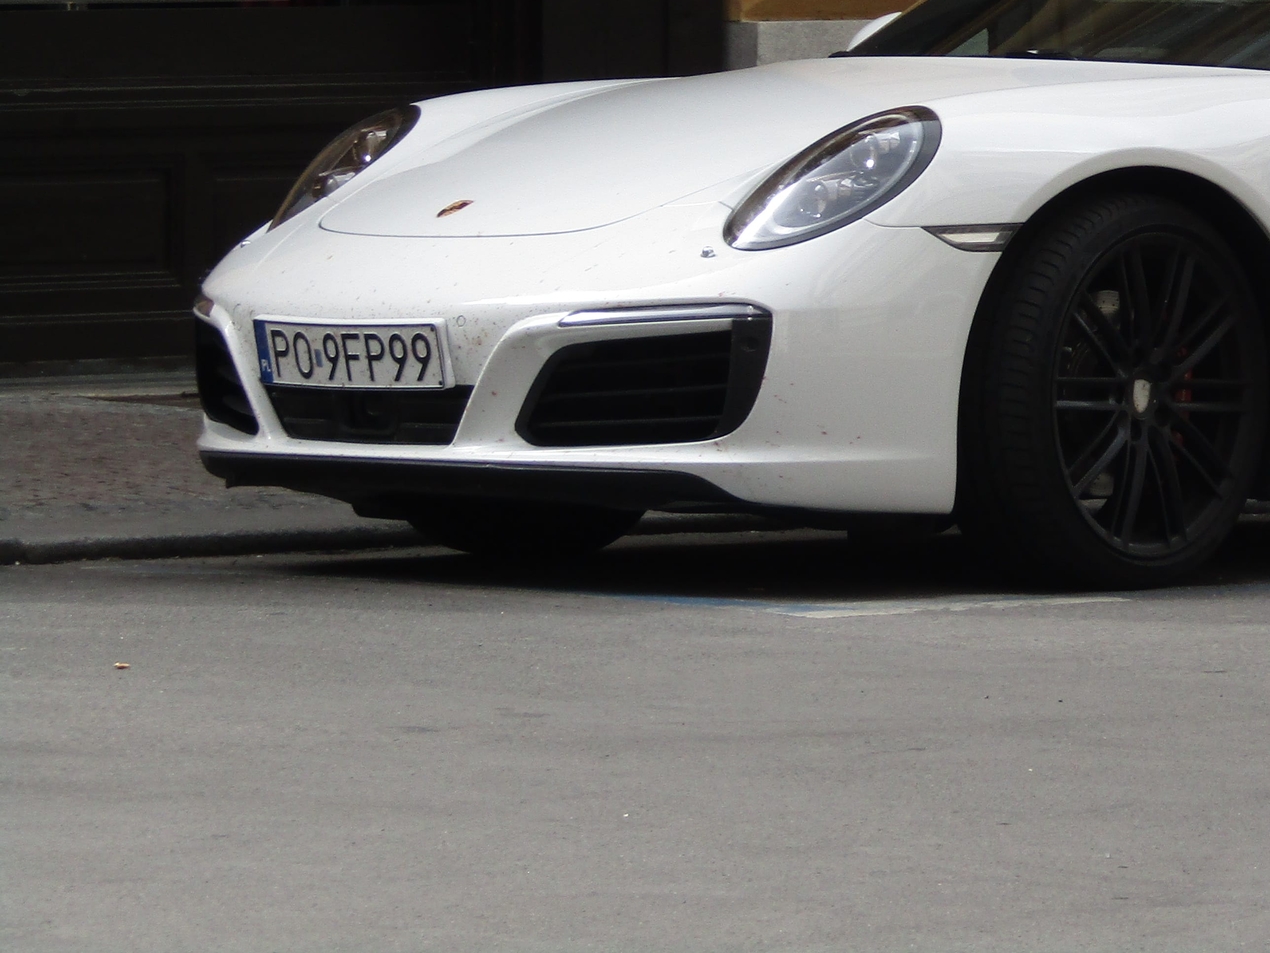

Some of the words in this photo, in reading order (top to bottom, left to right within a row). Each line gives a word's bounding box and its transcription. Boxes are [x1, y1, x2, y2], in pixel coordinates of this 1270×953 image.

[262, 360, 271, 373] PL
[270, 329, 313, 380] PO
[322, 332, 432, 382] 9FP99
